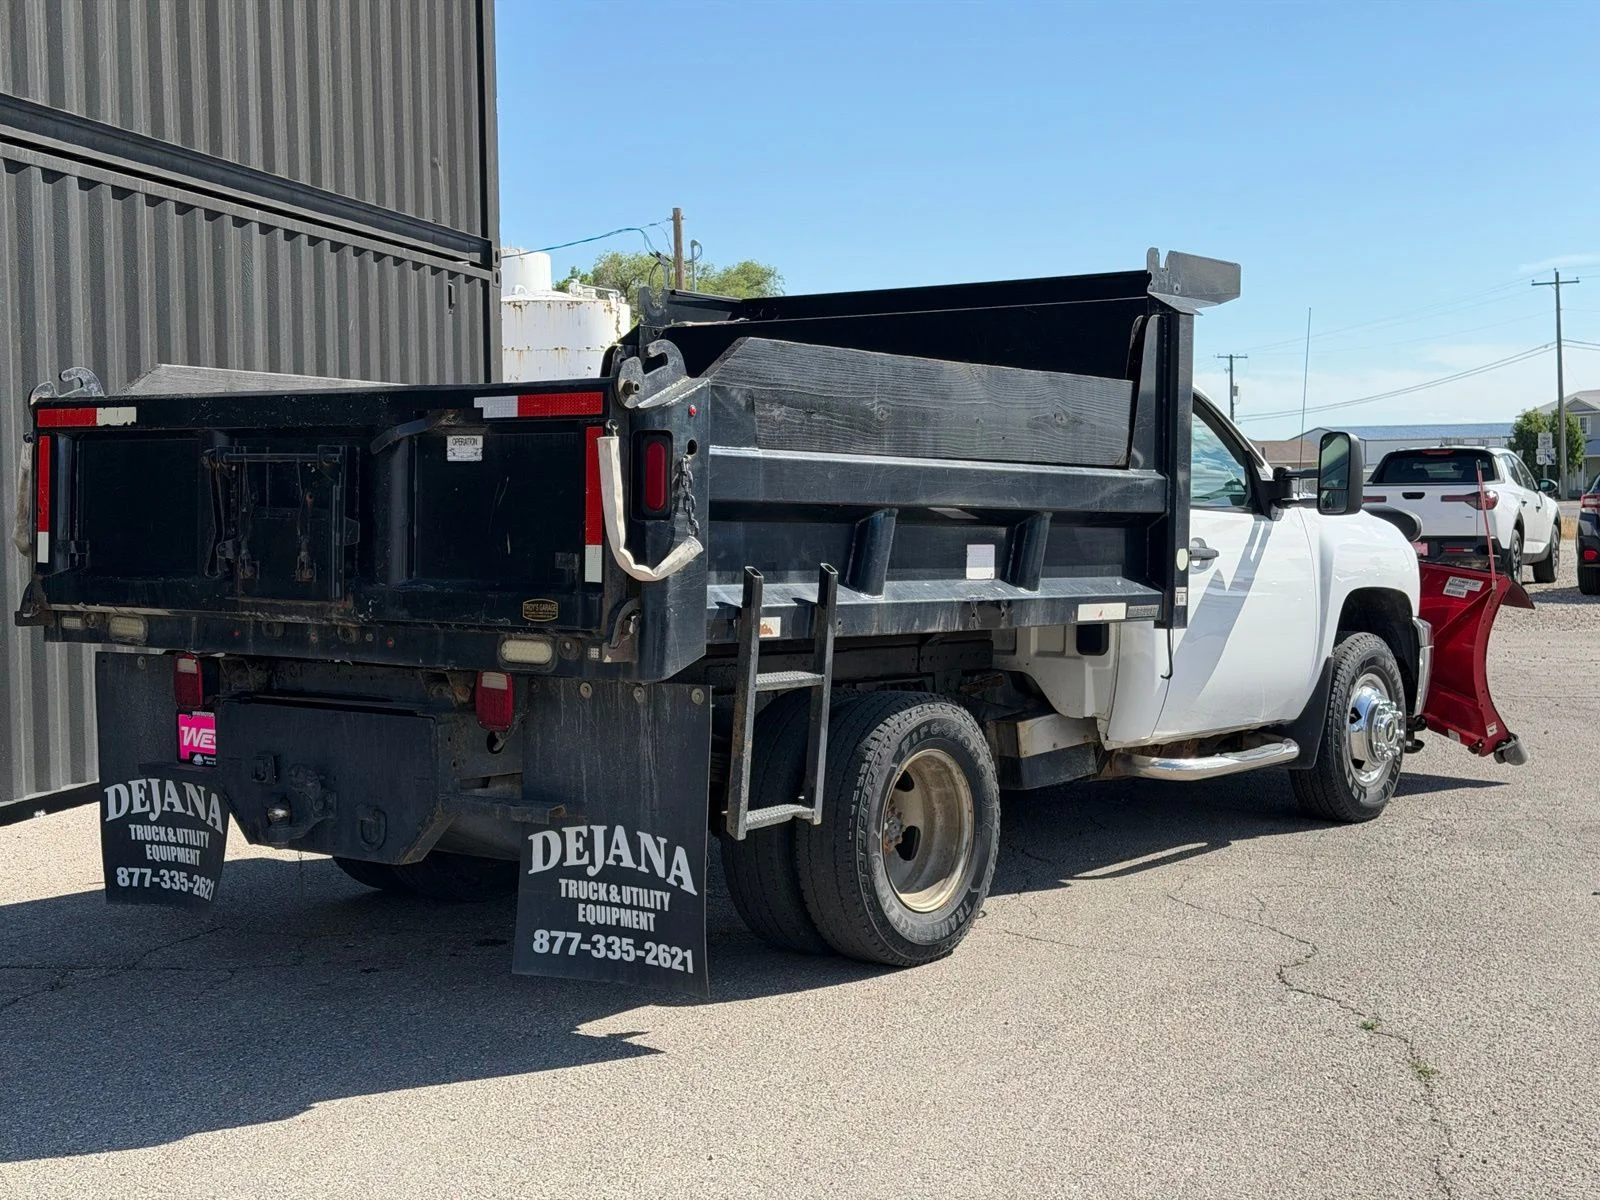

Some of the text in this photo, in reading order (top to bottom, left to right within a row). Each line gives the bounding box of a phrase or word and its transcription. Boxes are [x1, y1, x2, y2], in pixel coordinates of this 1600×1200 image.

[181, 726, 217, 749] WE
[104, 778, 224, 835] DEJANA
[145, 844, 201, 867] EQUIPMENT
[527, 824, 698, 896] DEJANA
[116, 866, 215, 901] 877-335-2621
[577, 903, 656, 932] EQUIPMENT
[532, 928, 694, 974] 877-335-2621
